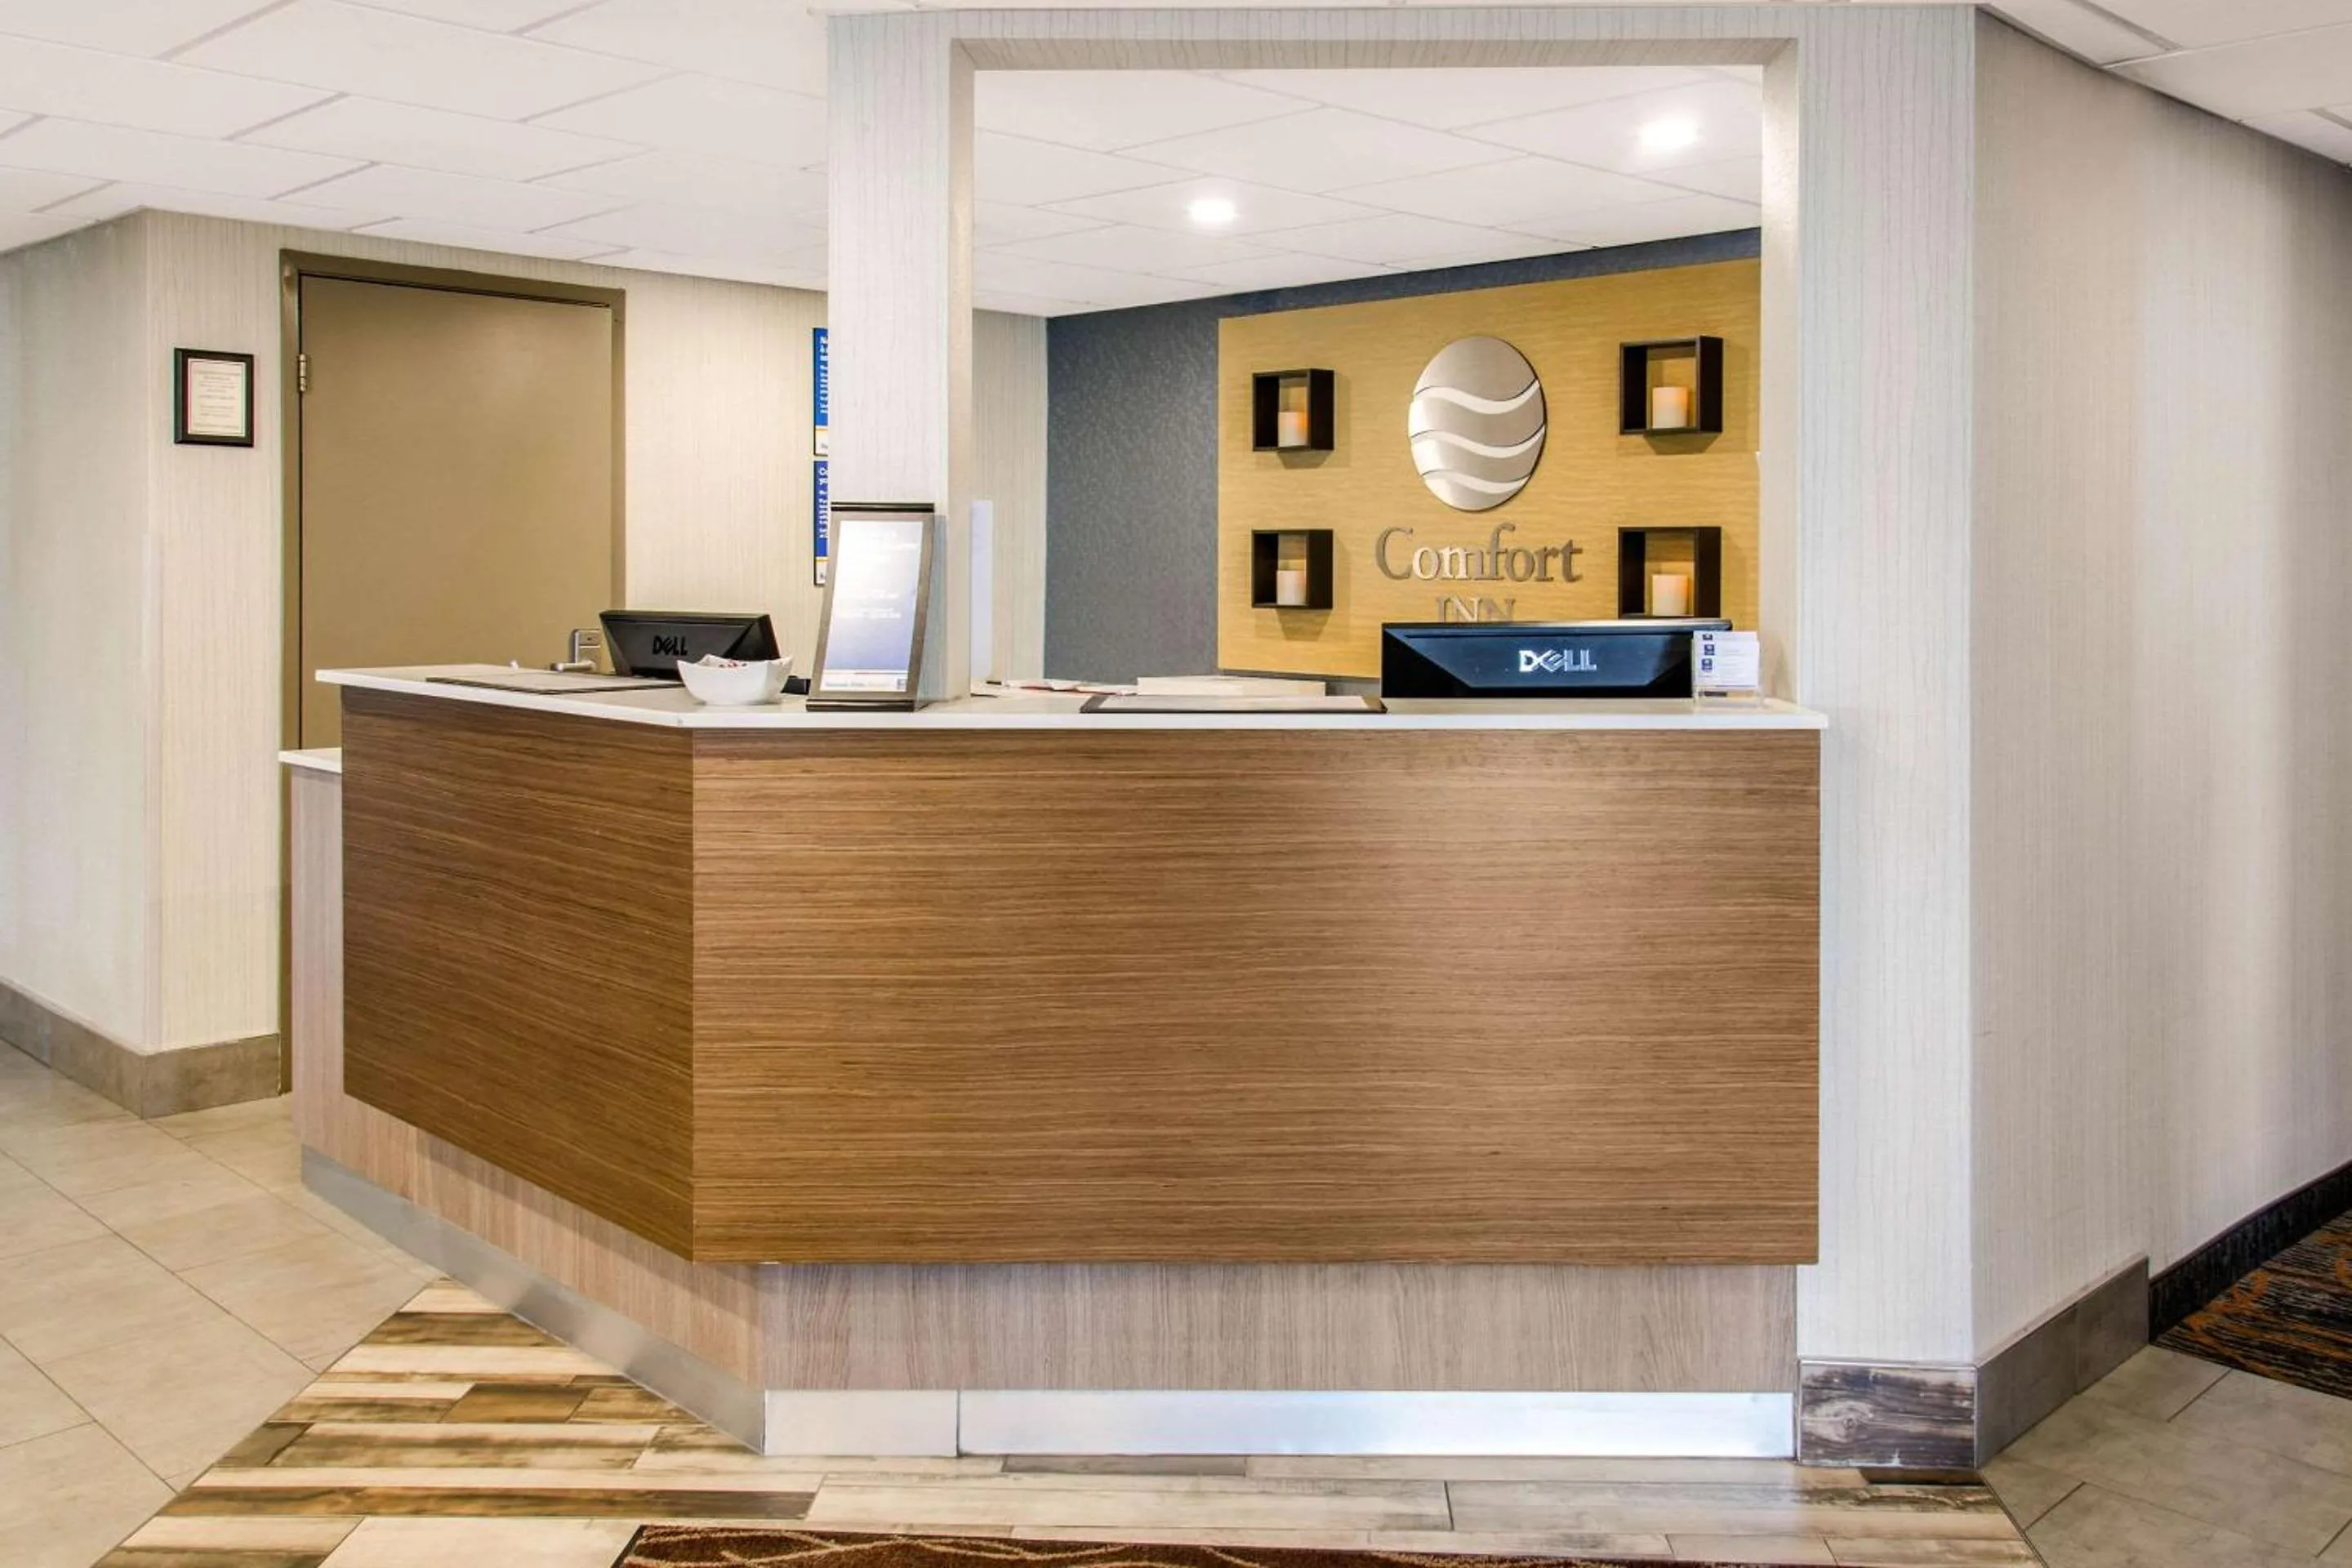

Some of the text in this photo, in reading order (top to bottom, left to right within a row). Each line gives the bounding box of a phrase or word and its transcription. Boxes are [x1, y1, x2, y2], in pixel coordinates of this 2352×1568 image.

[1375, 522, 1584, 582] Comfort
[1436, 595, 1516, 622] INN
[653, 635, 688, 656] DELL
[1518, 649, 1597, 672] DELL
